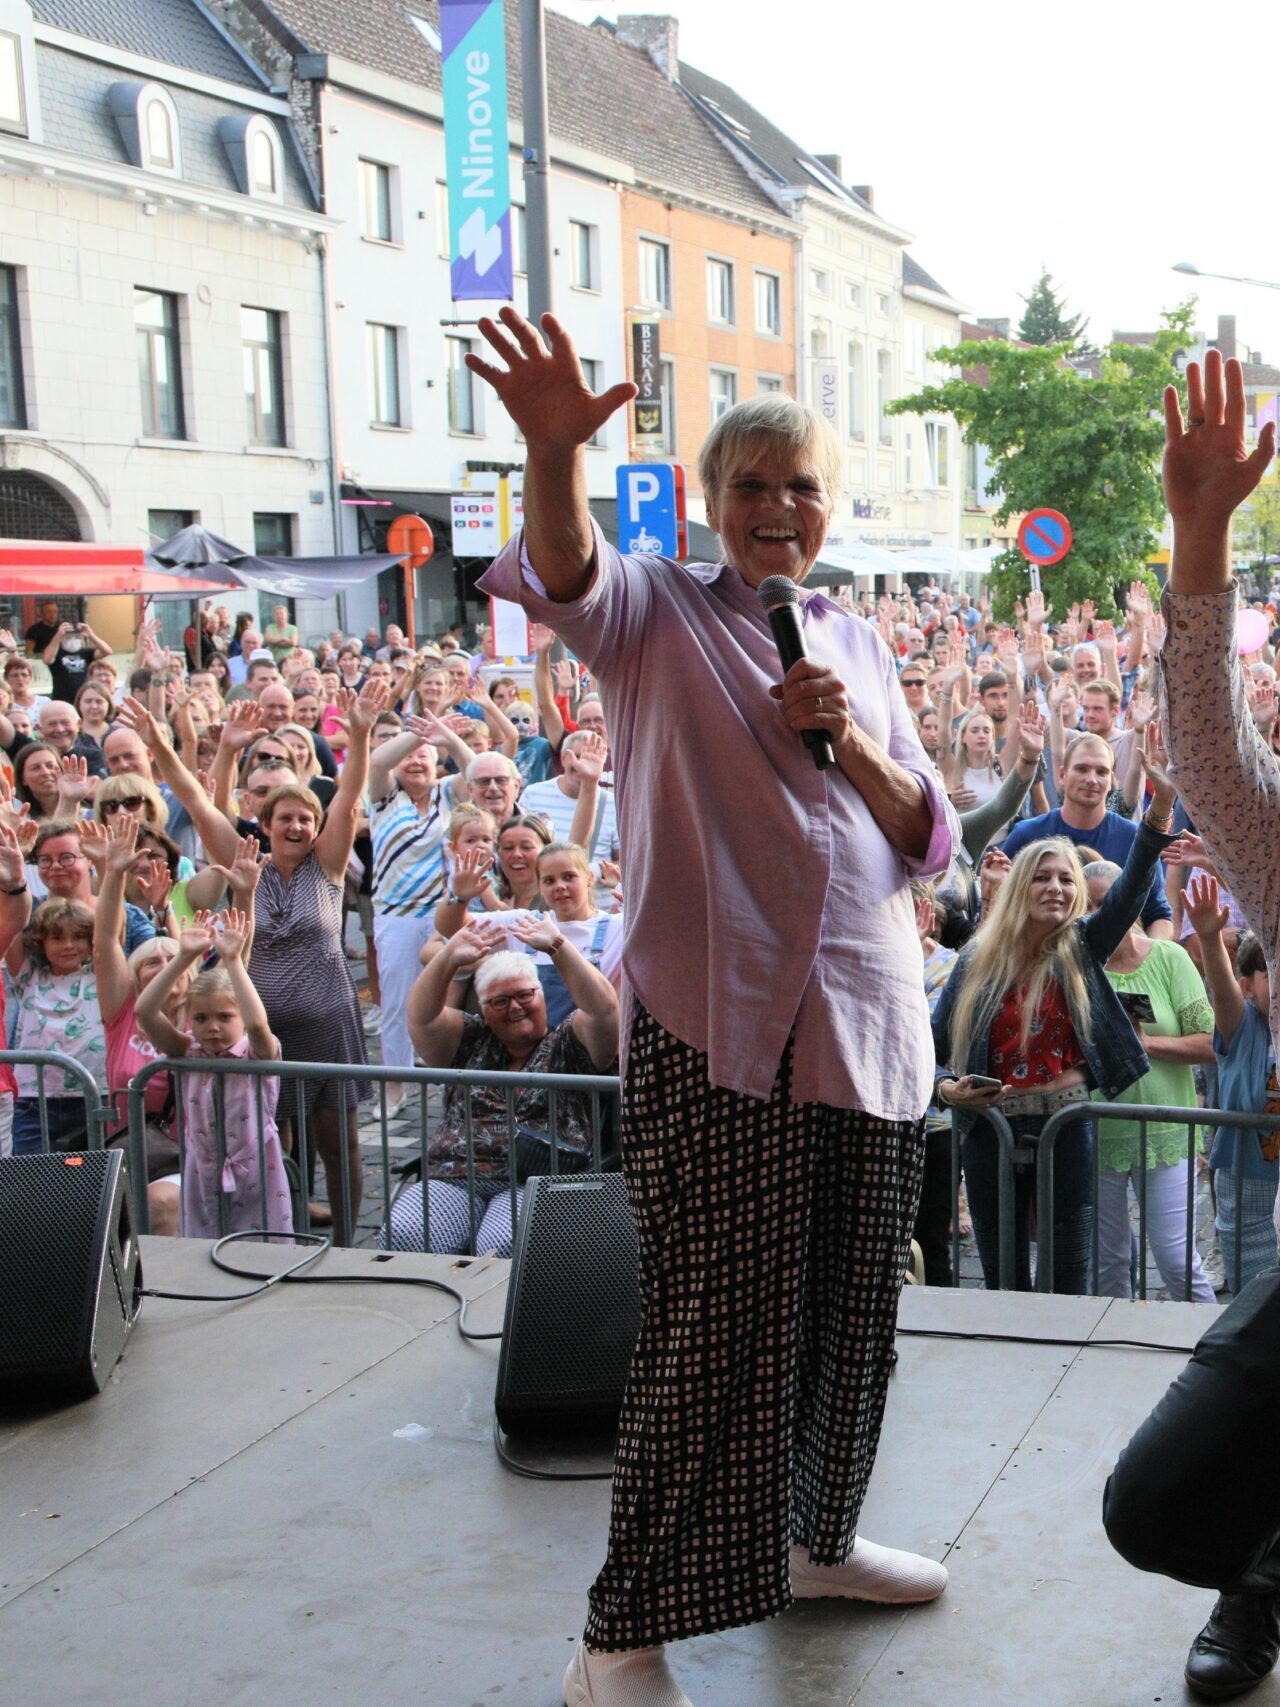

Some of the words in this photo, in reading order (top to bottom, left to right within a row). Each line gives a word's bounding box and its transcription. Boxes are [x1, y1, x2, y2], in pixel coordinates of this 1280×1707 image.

[461, 50, 495, 198] Ninove
[640, 323, 654, 398] BEKAS
[822, 373, 836, 423] erve
[628, 472, 660, 523] P
